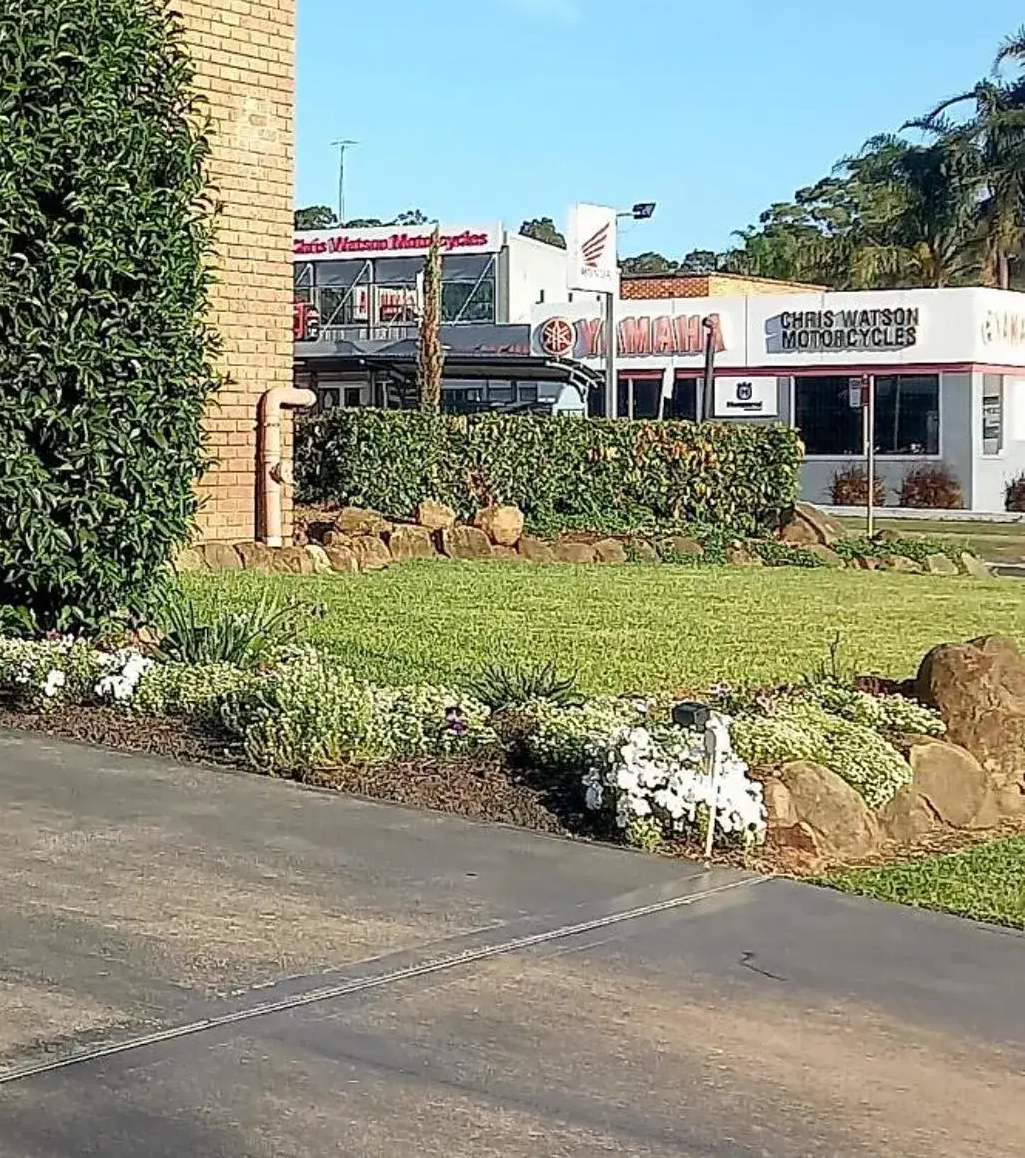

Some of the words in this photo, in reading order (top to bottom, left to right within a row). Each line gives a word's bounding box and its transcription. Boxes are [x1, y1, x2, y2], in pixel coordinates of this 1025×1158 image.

[328, 236, 388, 252] Watson
[388, 230, 488, 251] Motocycles
[780, 310, 834, 329] CHRIS
[840, 307, 919, 328] WATSON
[574, 314, 726, 358] YMAHA
[782, 326, 916, 349] MOTORCYCLES
